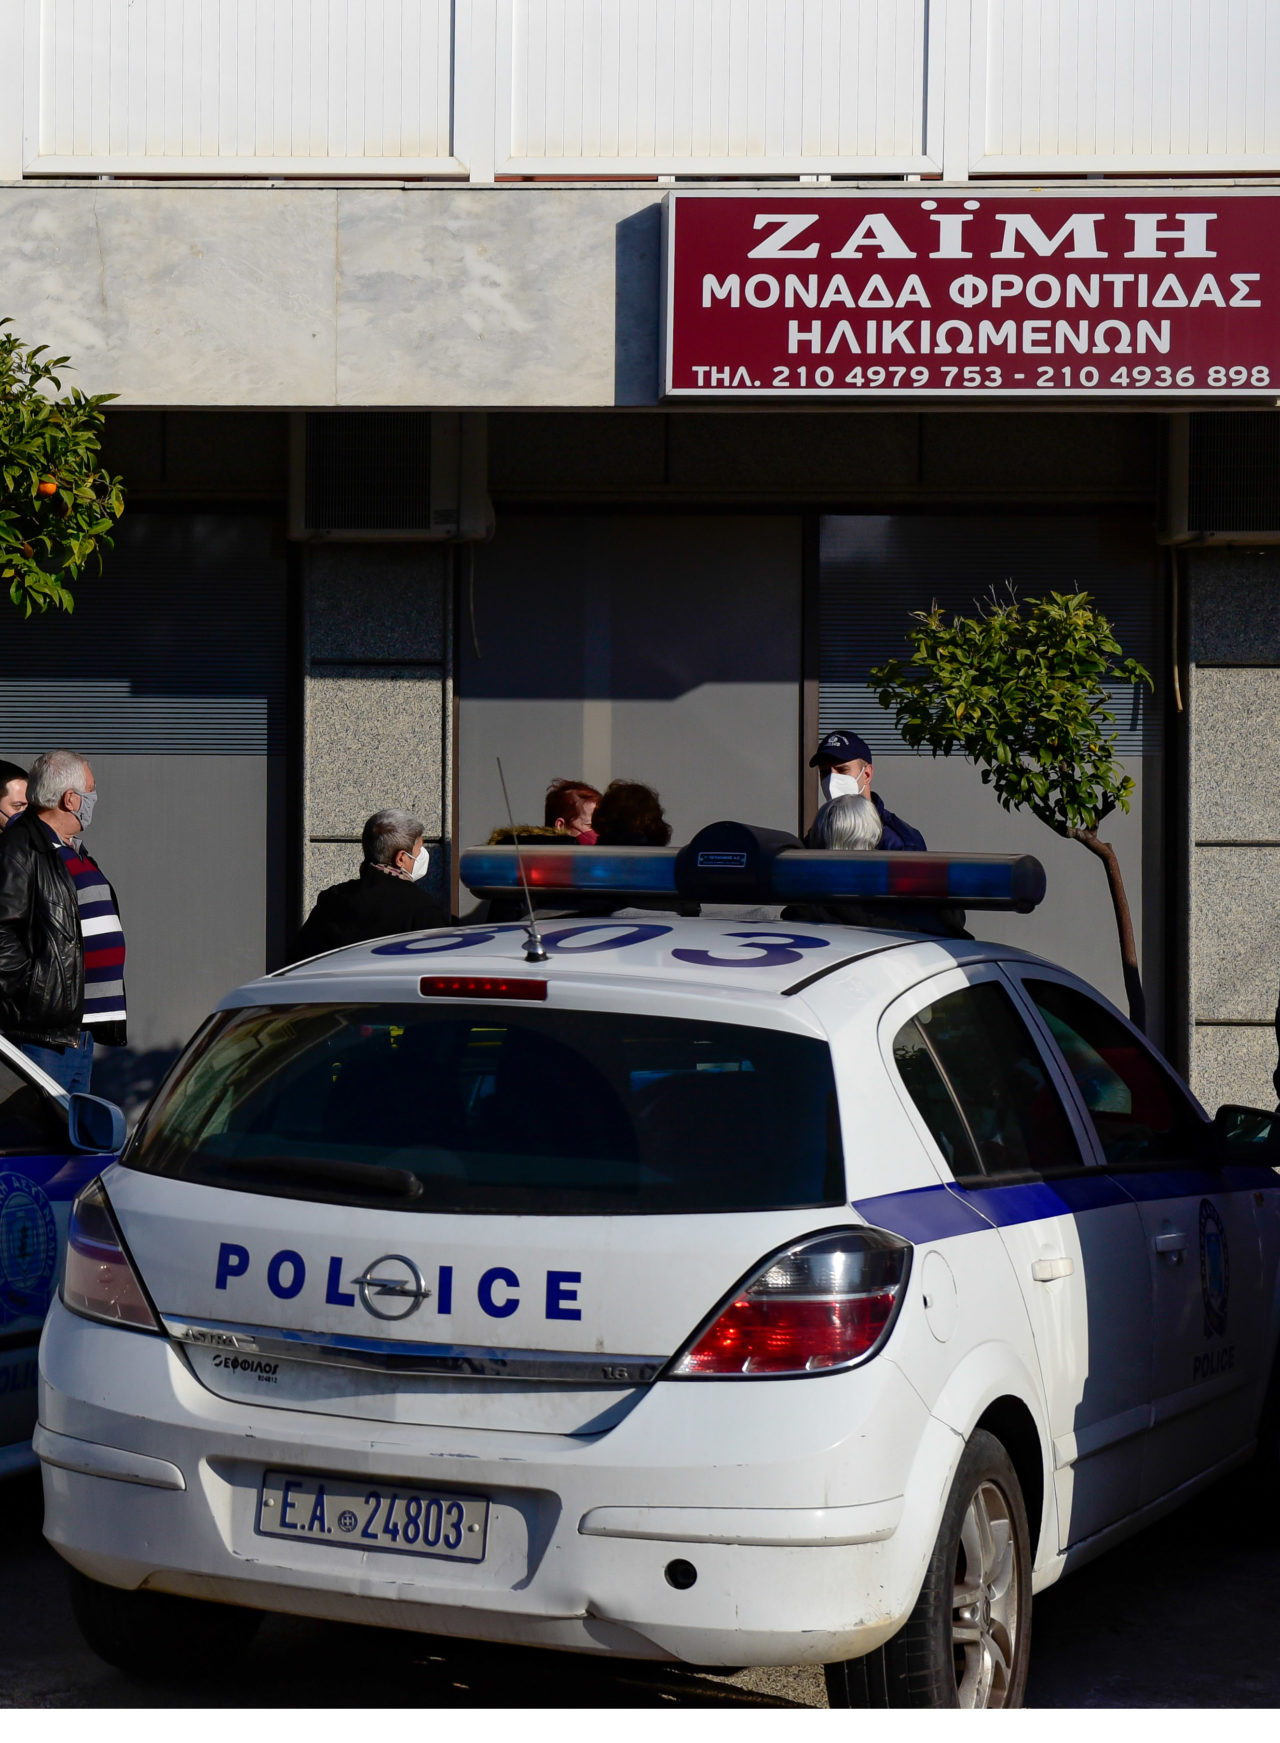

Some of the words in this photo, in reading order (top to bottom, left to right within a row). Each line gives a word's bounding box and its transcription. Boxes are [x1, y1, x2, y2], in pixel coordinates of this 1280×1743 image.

[747, 200, 1218, 260] ΖΑΪΜΗ
[701, 273, 932, 309] ΜΟΝΑΔΑ
[949, 273, 1262, 309] ΦΡΟΝΤΙΔΑΣ
[788, 319, 1171, 354] ΗΛΙΚΙΩΜΕΝΩΝ
[692, 366, 761, 387] ΤΗΛ.
[772, 366, 834, 387] 210
[845, 366, 929, 387] 4979
[940, 366, 1002, 388] 753
[1036, 366, 1099, 387] 210
[1110, 366, 1195, 387] 4936
[1207, 366, 1270, 387] 898
[215, 1243, 582, 1321] POLICE
[1192, 1345, 1235, 1381] POLICE
[361, 1490, 465, 1550] 24803
